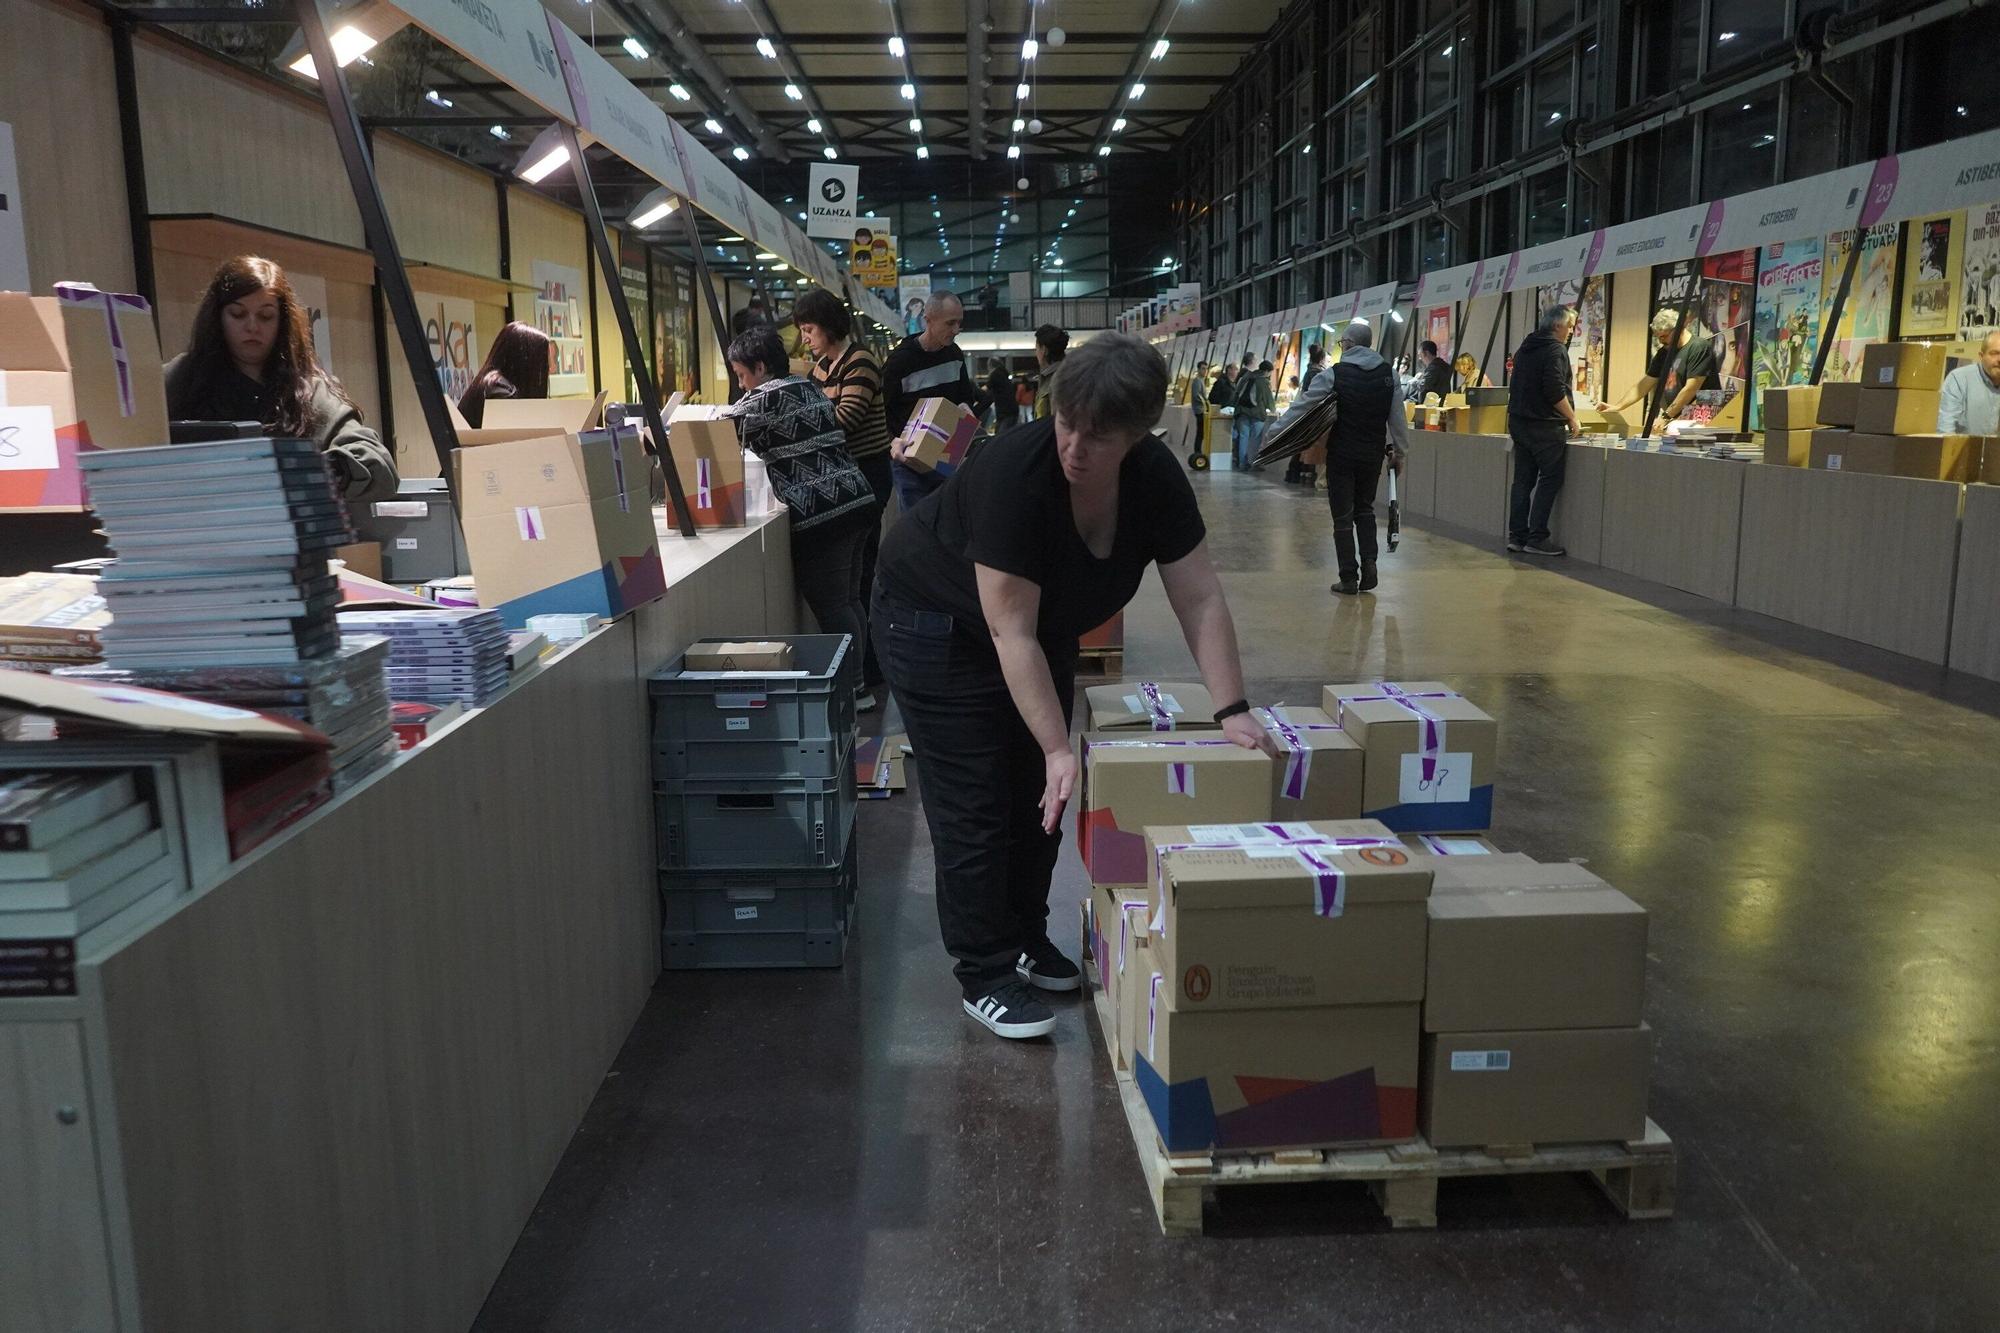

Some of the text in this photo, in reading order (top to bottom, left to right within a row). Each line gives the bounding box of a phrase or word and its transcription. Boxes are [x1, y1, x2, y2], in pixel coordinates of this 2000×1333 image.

[812, 206, 852, 218] UZANZA
[1758, 206, 1799, 227] ASTIBERRI
[426, 302, 472, 369] elkar
